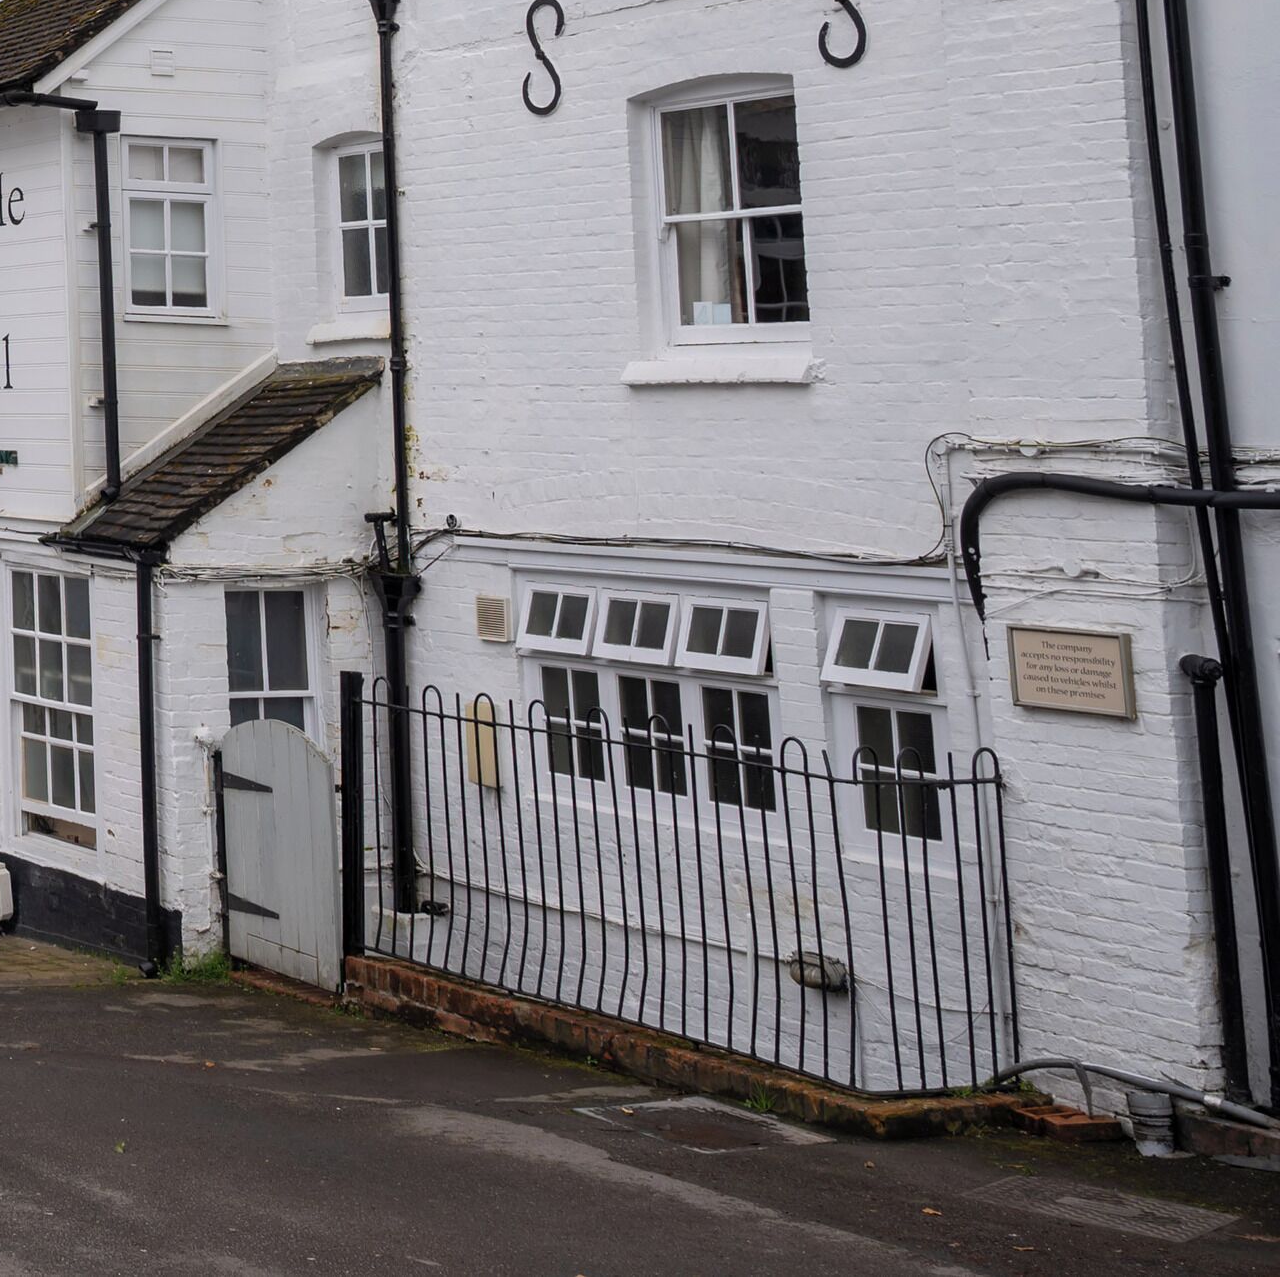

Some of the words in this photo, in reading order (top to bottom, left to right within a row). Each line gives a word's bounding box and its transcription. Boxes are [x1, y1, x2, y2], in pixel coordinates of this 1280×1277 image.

[1042, 641, 1056, 651] The
[1057, 644, 1093, 654] company
[1021, 652, 1049, 661] accepts
[1062, 655, 1115, 667] responsibility
[1026, 662, 1036, 670] for
[1038, 664, 1053, 672] any
[1054, 664, 1069, 674] loss
[1080, 667, 1112, 678] damage
[1023, 673, 1049, 683] caused
[1060, 676, 1091, 687] vehicles
[1092, 680, 1117, 689] whilst
[1048, 686, 1069, 696] these
[1070, 690, 1105, 699] premises
